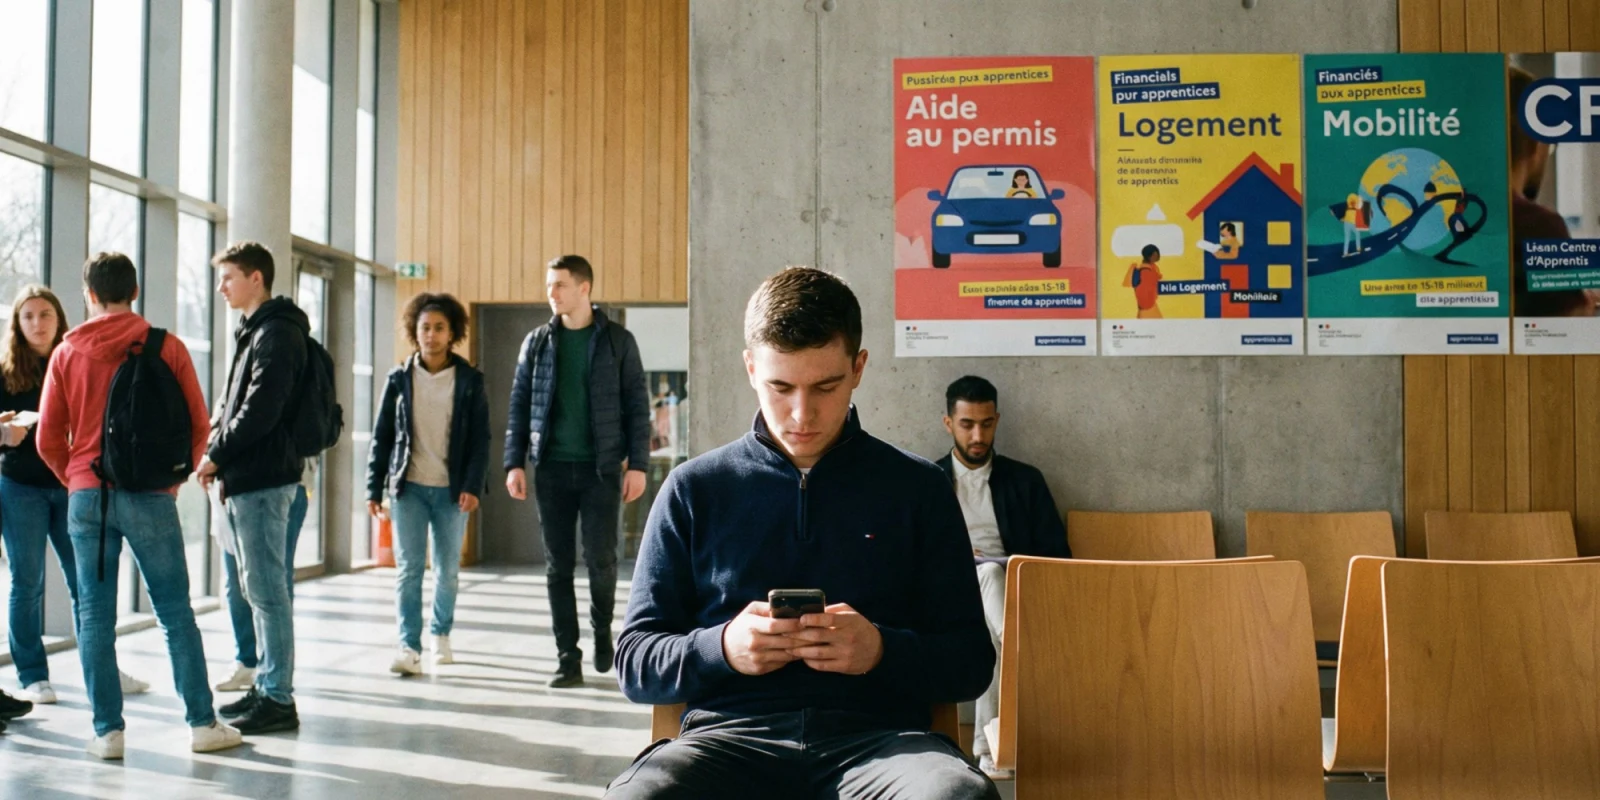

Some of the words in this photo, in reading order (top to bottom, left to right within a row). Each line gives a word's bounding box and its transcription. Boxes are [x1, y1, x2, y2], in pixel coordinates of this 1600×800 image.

[983, 69, 1050, 84] apprentices
[1318, 69, 1379, 83] Financiés
[1115, 90, 1138, 104] pur
[1141, 85, 1217, 102] apprentices
[1347, 84, 1422, 101] apprentices
[905, 93, 978, 120] Aide
[1118, 112, 1283, 145] Logement
[1323, 108, 1461, 137] Mobilité
[906, 127, 942, 147] au
[953, 119, 1058, 154] permis
[1560, 242, 1597, 253] Centre
[1526, 255, 1589, 268] d'Apprentis
[1179, 281, 1228, 294] Logement
